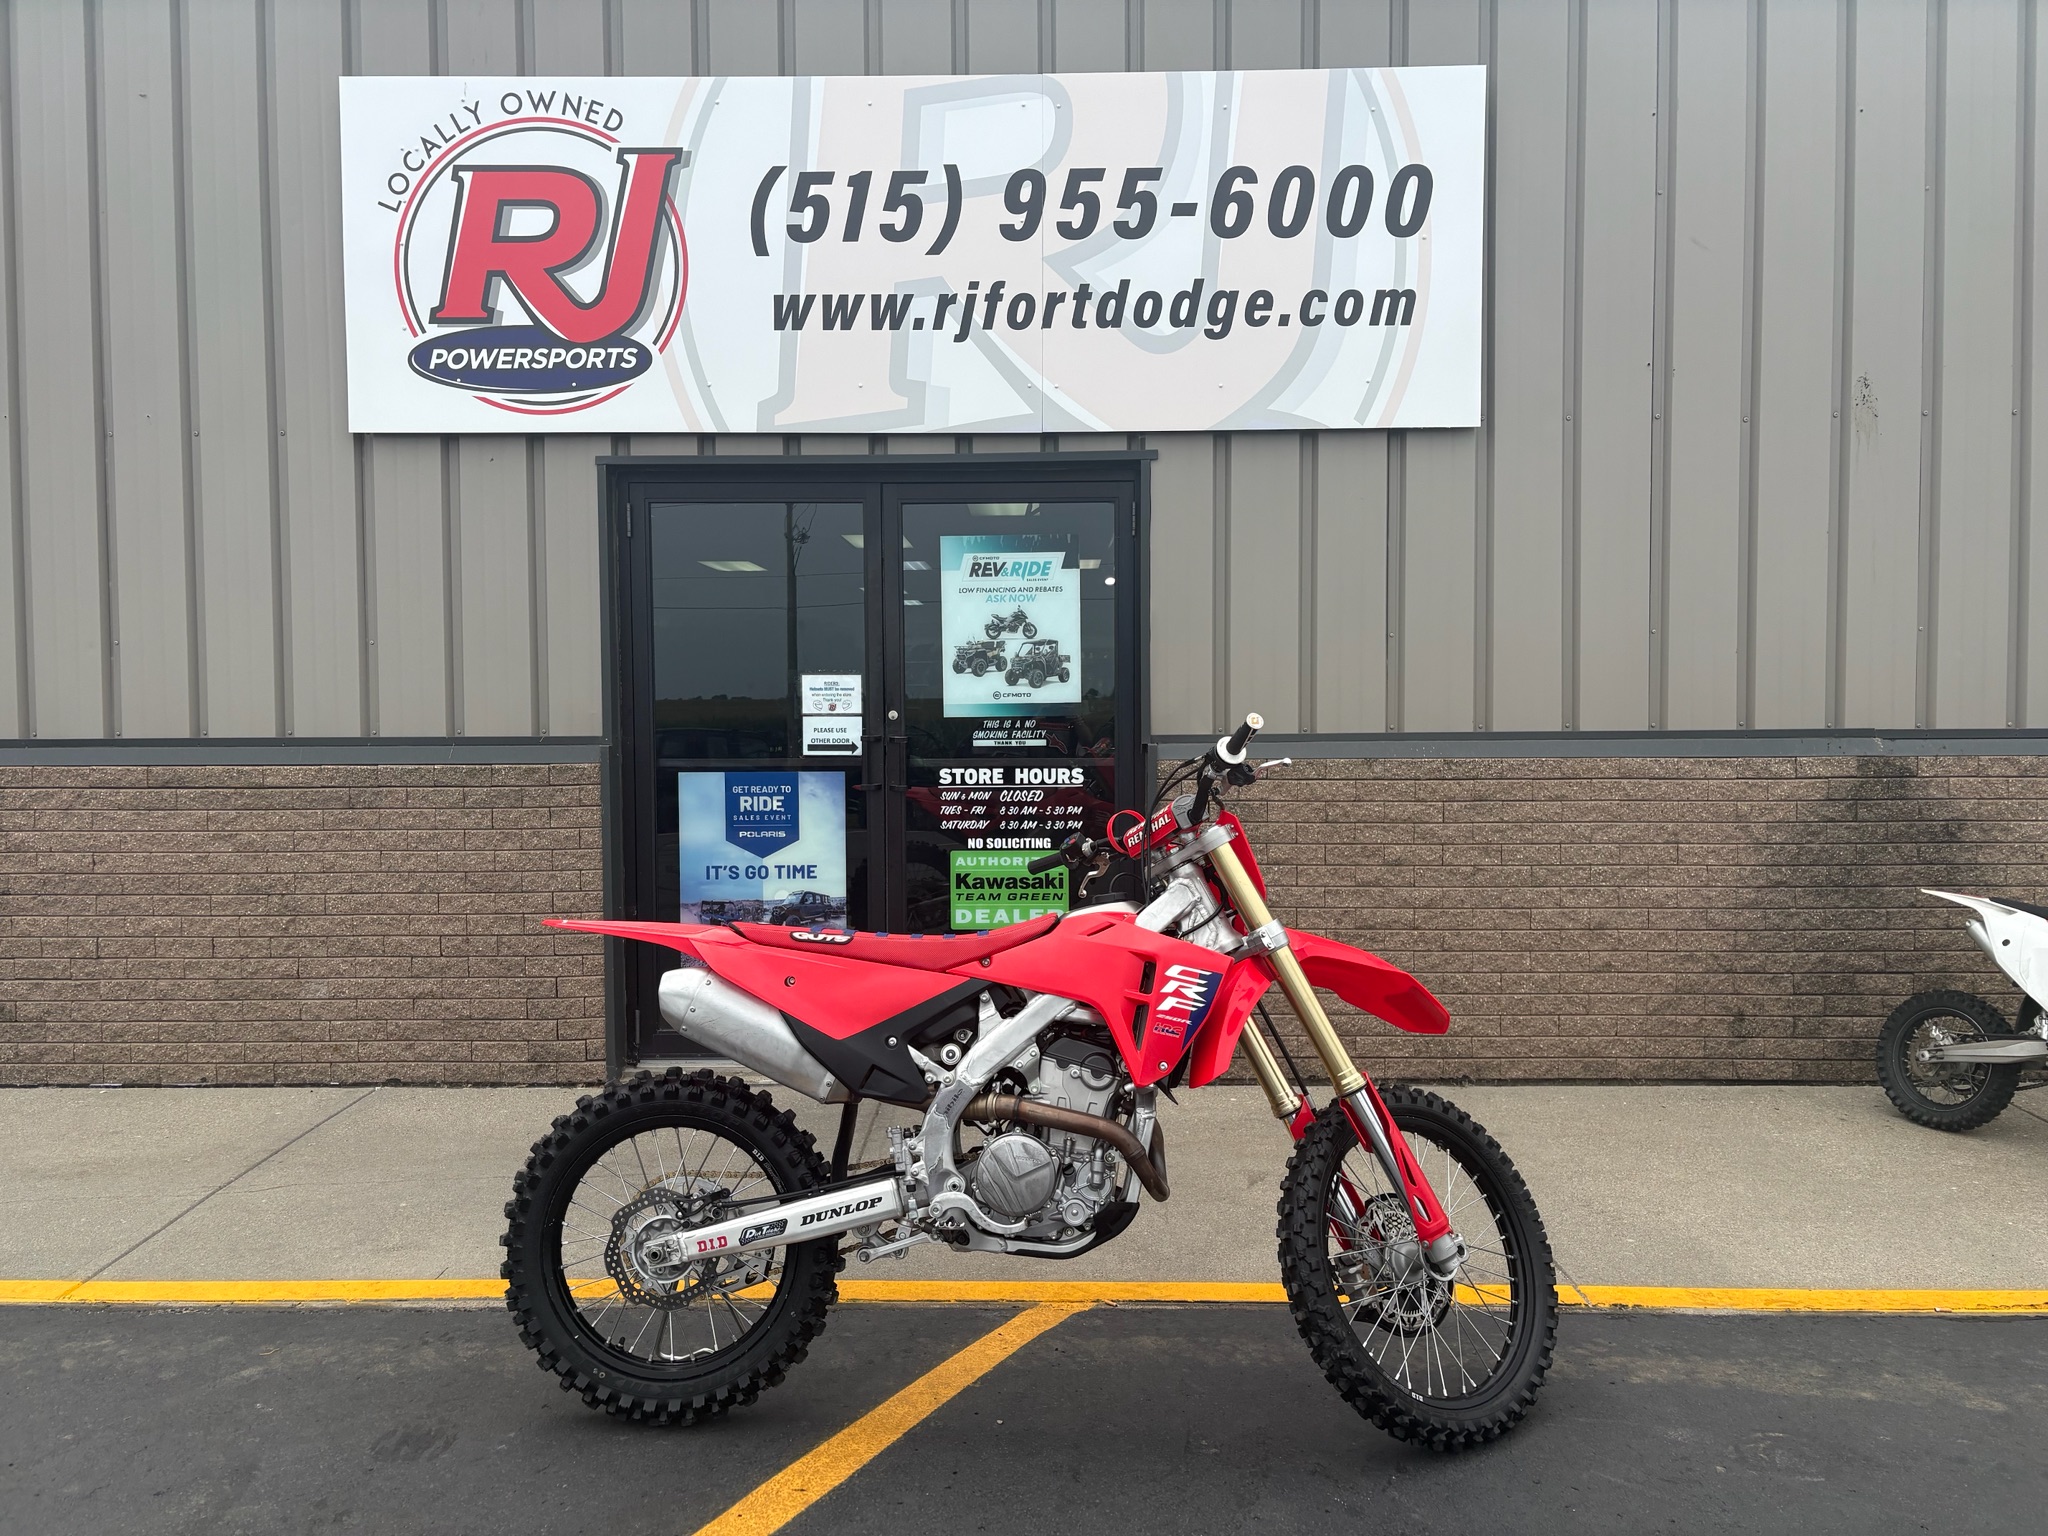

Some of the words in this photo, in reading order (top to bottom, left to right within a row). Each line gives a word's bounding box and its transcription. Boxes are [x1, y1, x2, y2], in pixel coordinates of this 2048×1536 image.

[377, 100, 485, 214] LOCALLY
[500, 89, 624, 132] OWNED
[750, 164, 963, 256] (515)
[998, 163, 1434, 242] 955-6000
[428, 146, 693, 344] RJ
[772, 278, 1417, 343] www.rjfortdodge.com
[429, 346, 638, 371] POWERSPORTS
[985, 594, 1006, 603] ASK
[1008, 594, 1037, 603] NOW
[983, 720, 999, 728] THIS
[1002, 720, 1011, 728] IS
[1015, 720, 1021, 728] A
[1024, 720, 1036, 728] NO
[972, 730, 1008, 739] SMOKING
[1011, 730, 1046, 739] FACILITY
[938, 768, 1004, 785] STORE
[1015, 768, 1085, 785] HOURS
[732, 785, 749, 793] GET
[751, 785, 779, 793] READY
[780, 785, 792, 793] TO
[940, 791, 961, 801] SUN
[968, 791, 992, 801] MON
[1000, 790, 1044, 802] CLOSED
[739, 796, 785, 812] RIDE
[940, 806, 962, 815] TUES
[970, 806, 987, 815] FRI
[1020, 806, 1038, 815] AM
[1066, 806, 1083, 815] PM
[940, 820, 990, 830] SATURDAY
[1020, 820, 1038, 830] AM
[1066, 820, 1083, 830] PM
[967, 838, 983, 849] NO
[986, 838, 1052, 849] SOLICITING
[705, 865, 740, 880] IT'S
[744, 865, 770, 880] GO
[774, 865, 818, 880] TIME
[955, 873, 1065, 889] Kawasaki
[956, 893, 1001, 901] TEAM
[1007, 893, 1064, 901] GREEN
[792, 931, 851, 943] GUTS
[1156, 964, 1213, 1012] CRF
[1156, 1013, 1193, 1026] 250R
[800, 1197, 883, 1227] DUNLOP
[696, 1235, 728, 1253] D.I.D
